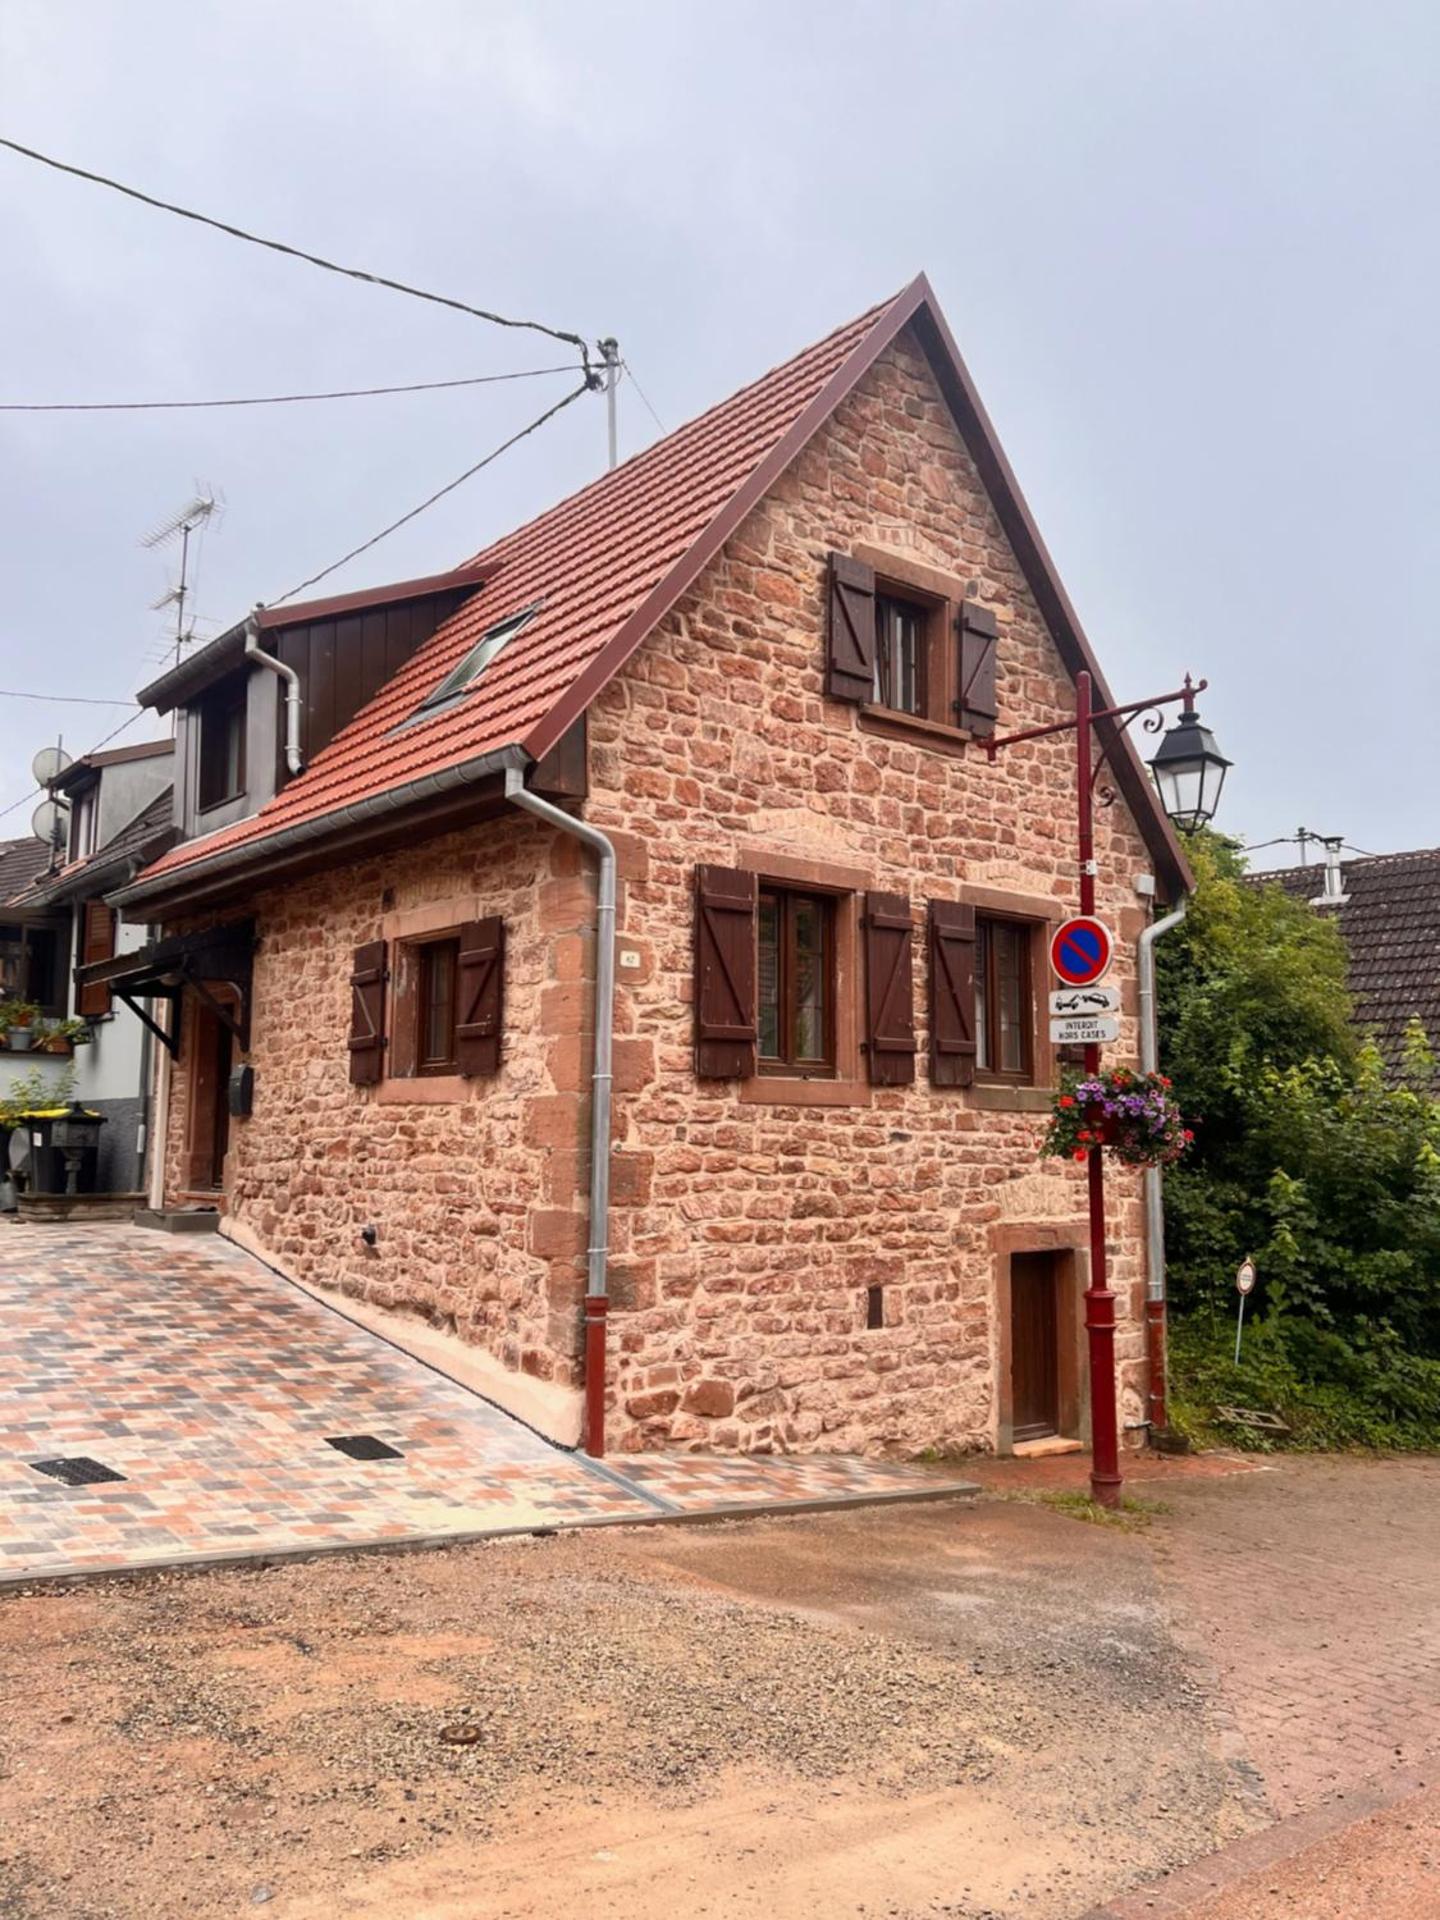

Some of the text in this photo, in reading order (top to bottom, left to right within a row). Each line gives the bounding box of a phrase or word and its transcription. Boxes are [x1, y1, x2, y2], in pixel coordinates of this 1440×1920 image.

[1065, 1021, 1098, 1030] INTERDIT
[1058, 1030, 1106, 1039] HORS CASES
